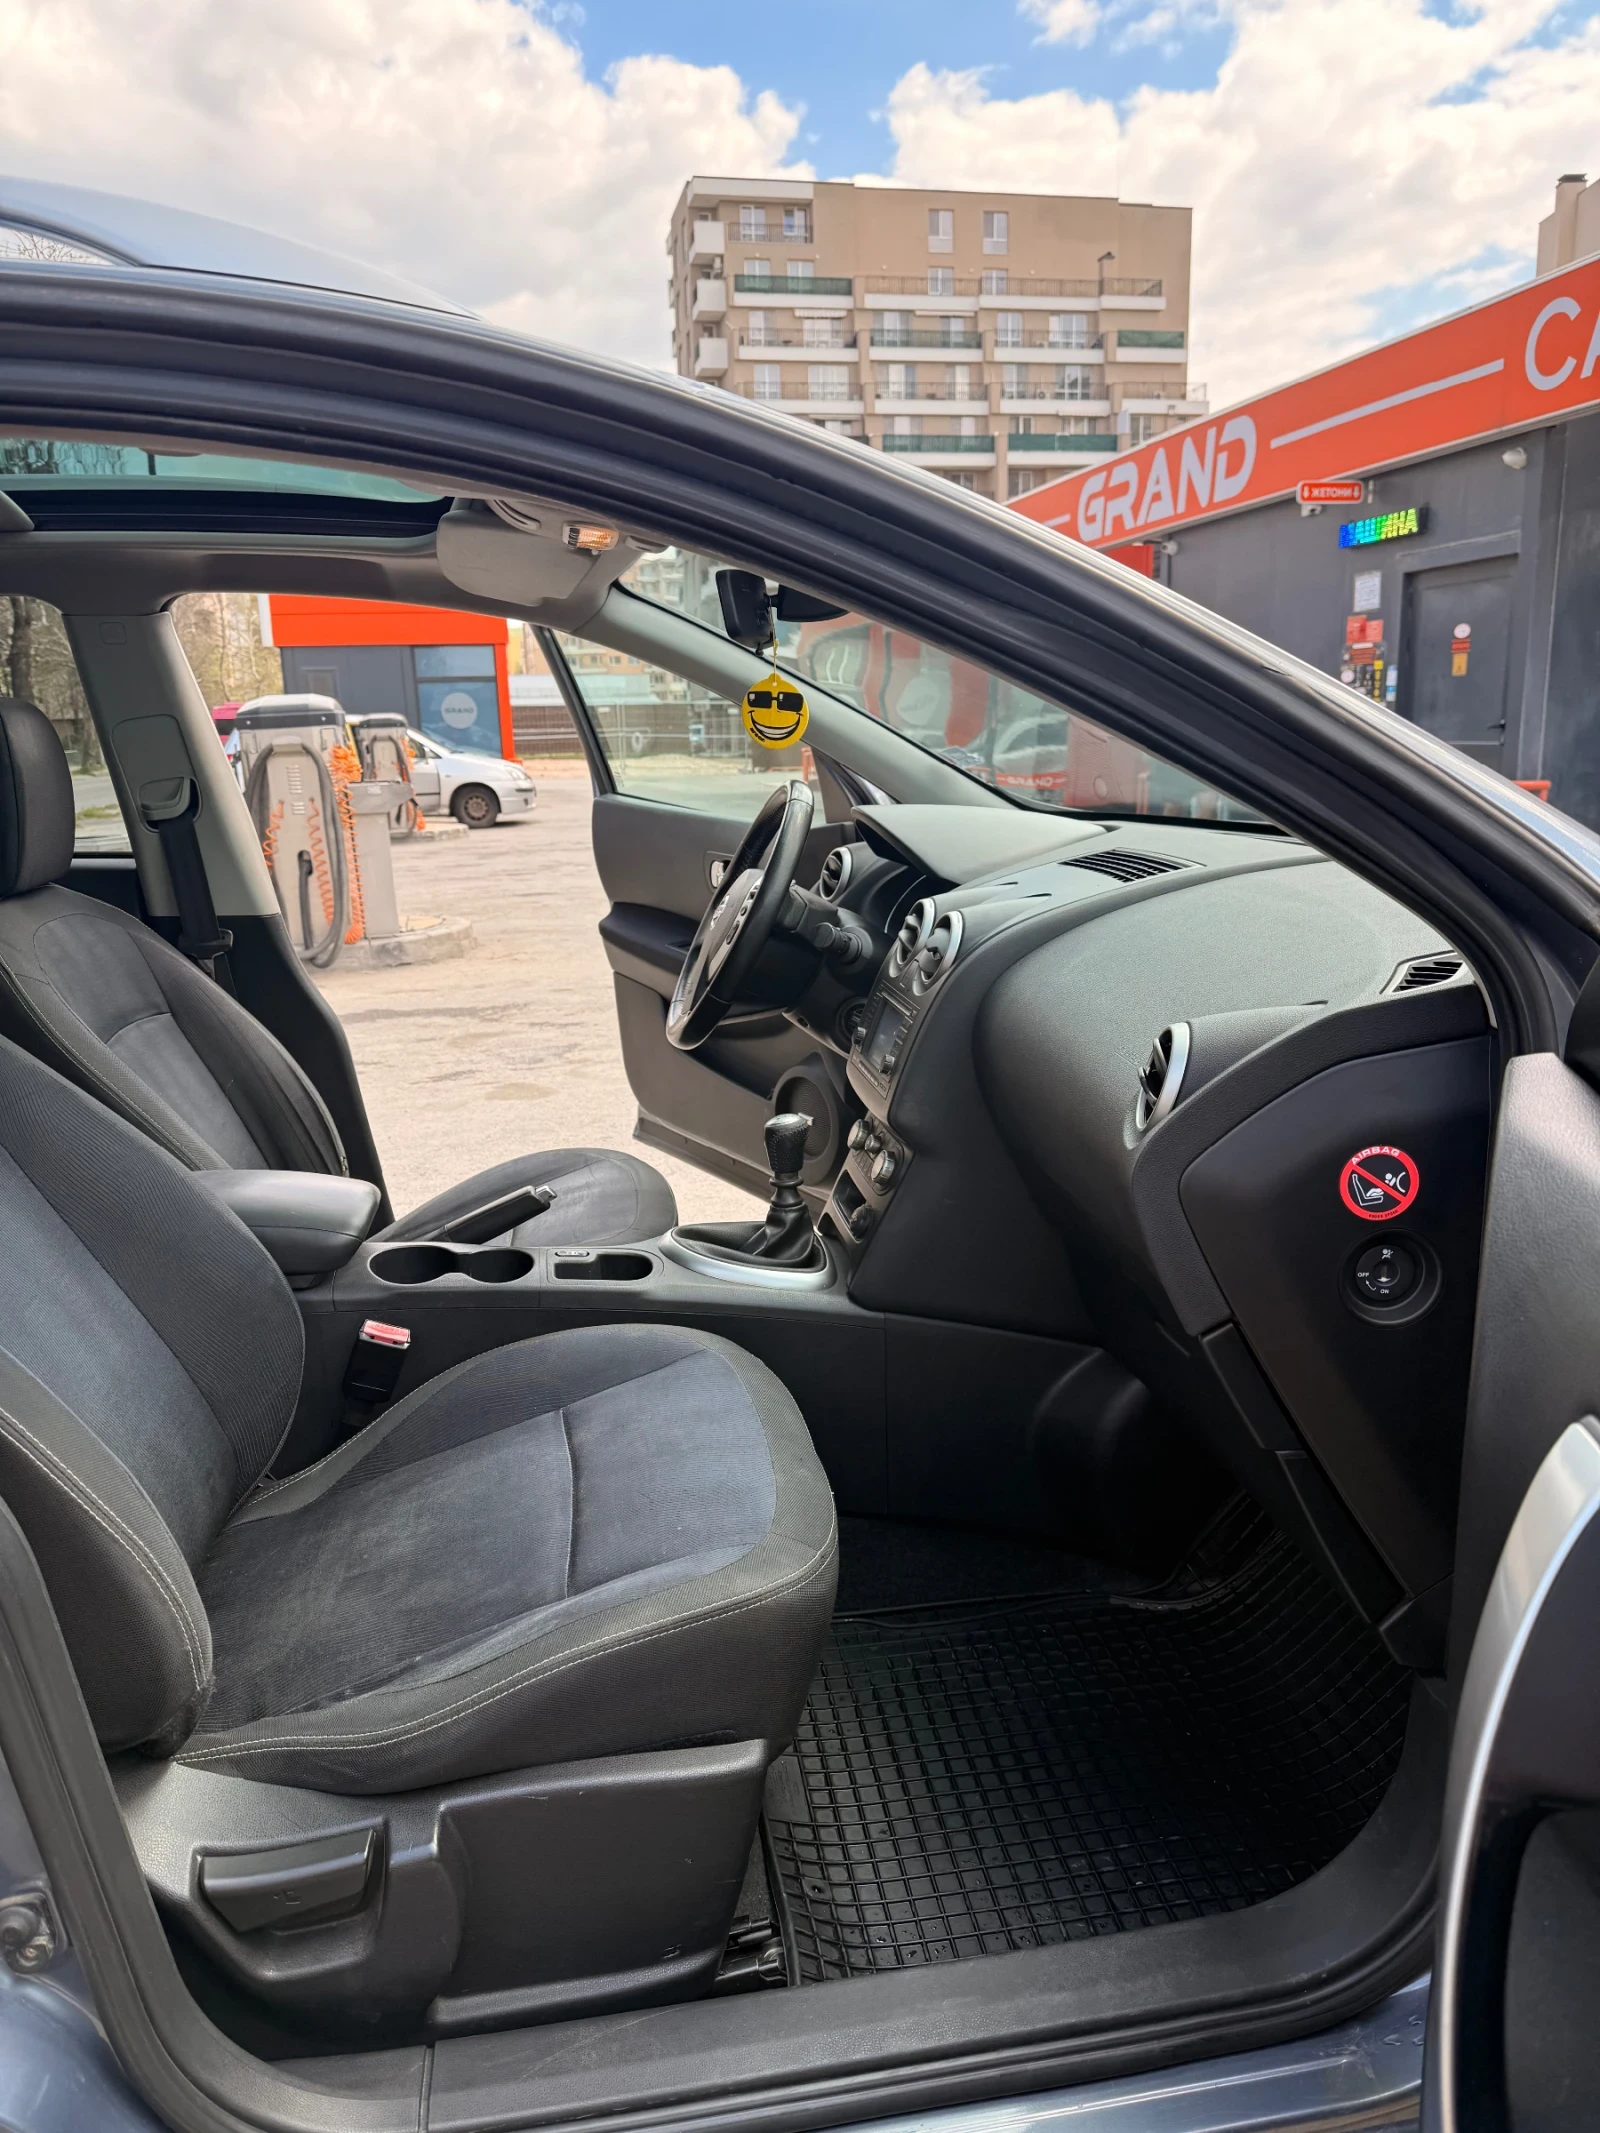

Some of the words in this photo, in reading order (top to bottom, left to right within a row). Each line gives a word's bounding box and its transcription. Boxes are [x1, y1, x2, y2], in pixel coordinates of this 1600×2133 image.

[1077, 415, 1257, 542] GRAND
[1310, 487, 1353, 498] ЖЕТОНИ
[1351, 1146, 1400, 1165] AIRBAG
